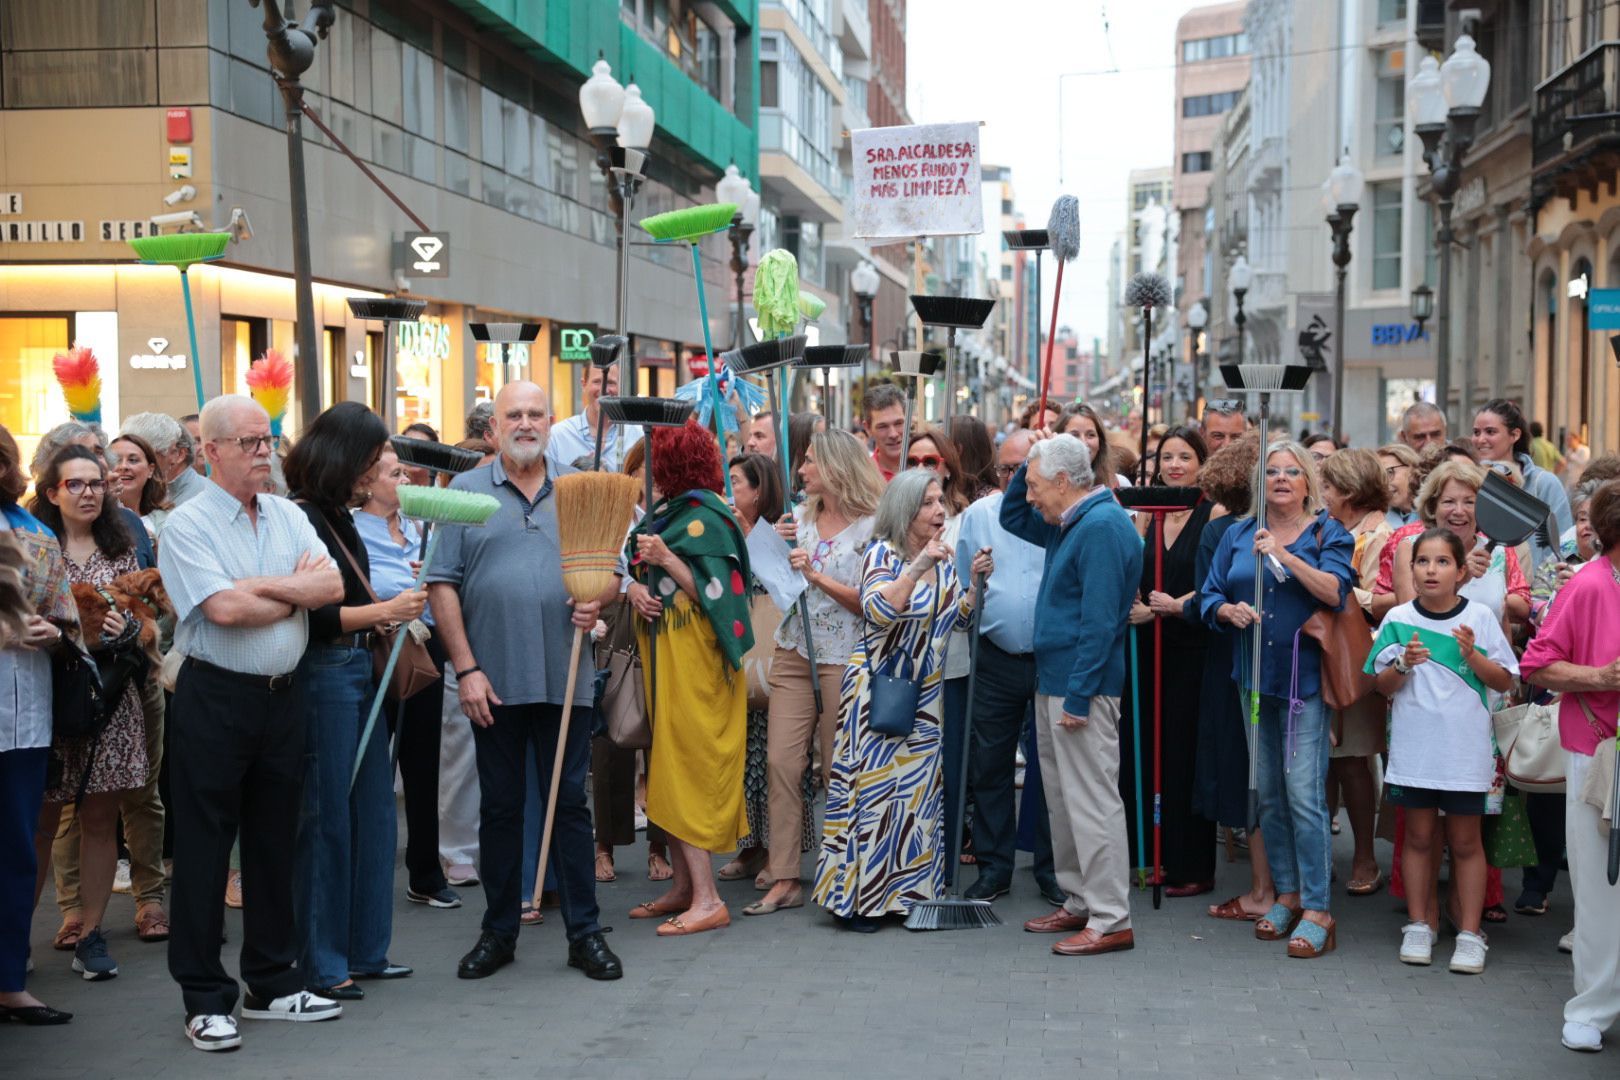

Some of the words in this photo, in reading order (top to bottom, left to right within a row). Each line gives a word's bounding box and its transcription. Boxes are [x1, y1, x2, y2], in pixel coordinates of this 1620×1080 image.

[873, 164, 918, 180] MENOS
[922, 162, 957, 177] RUIDO
[904, 178, 971, 197] LIMPIEZA.
[0, 195, 16, 213] E
[0, 223, 80, 241] RILLO
